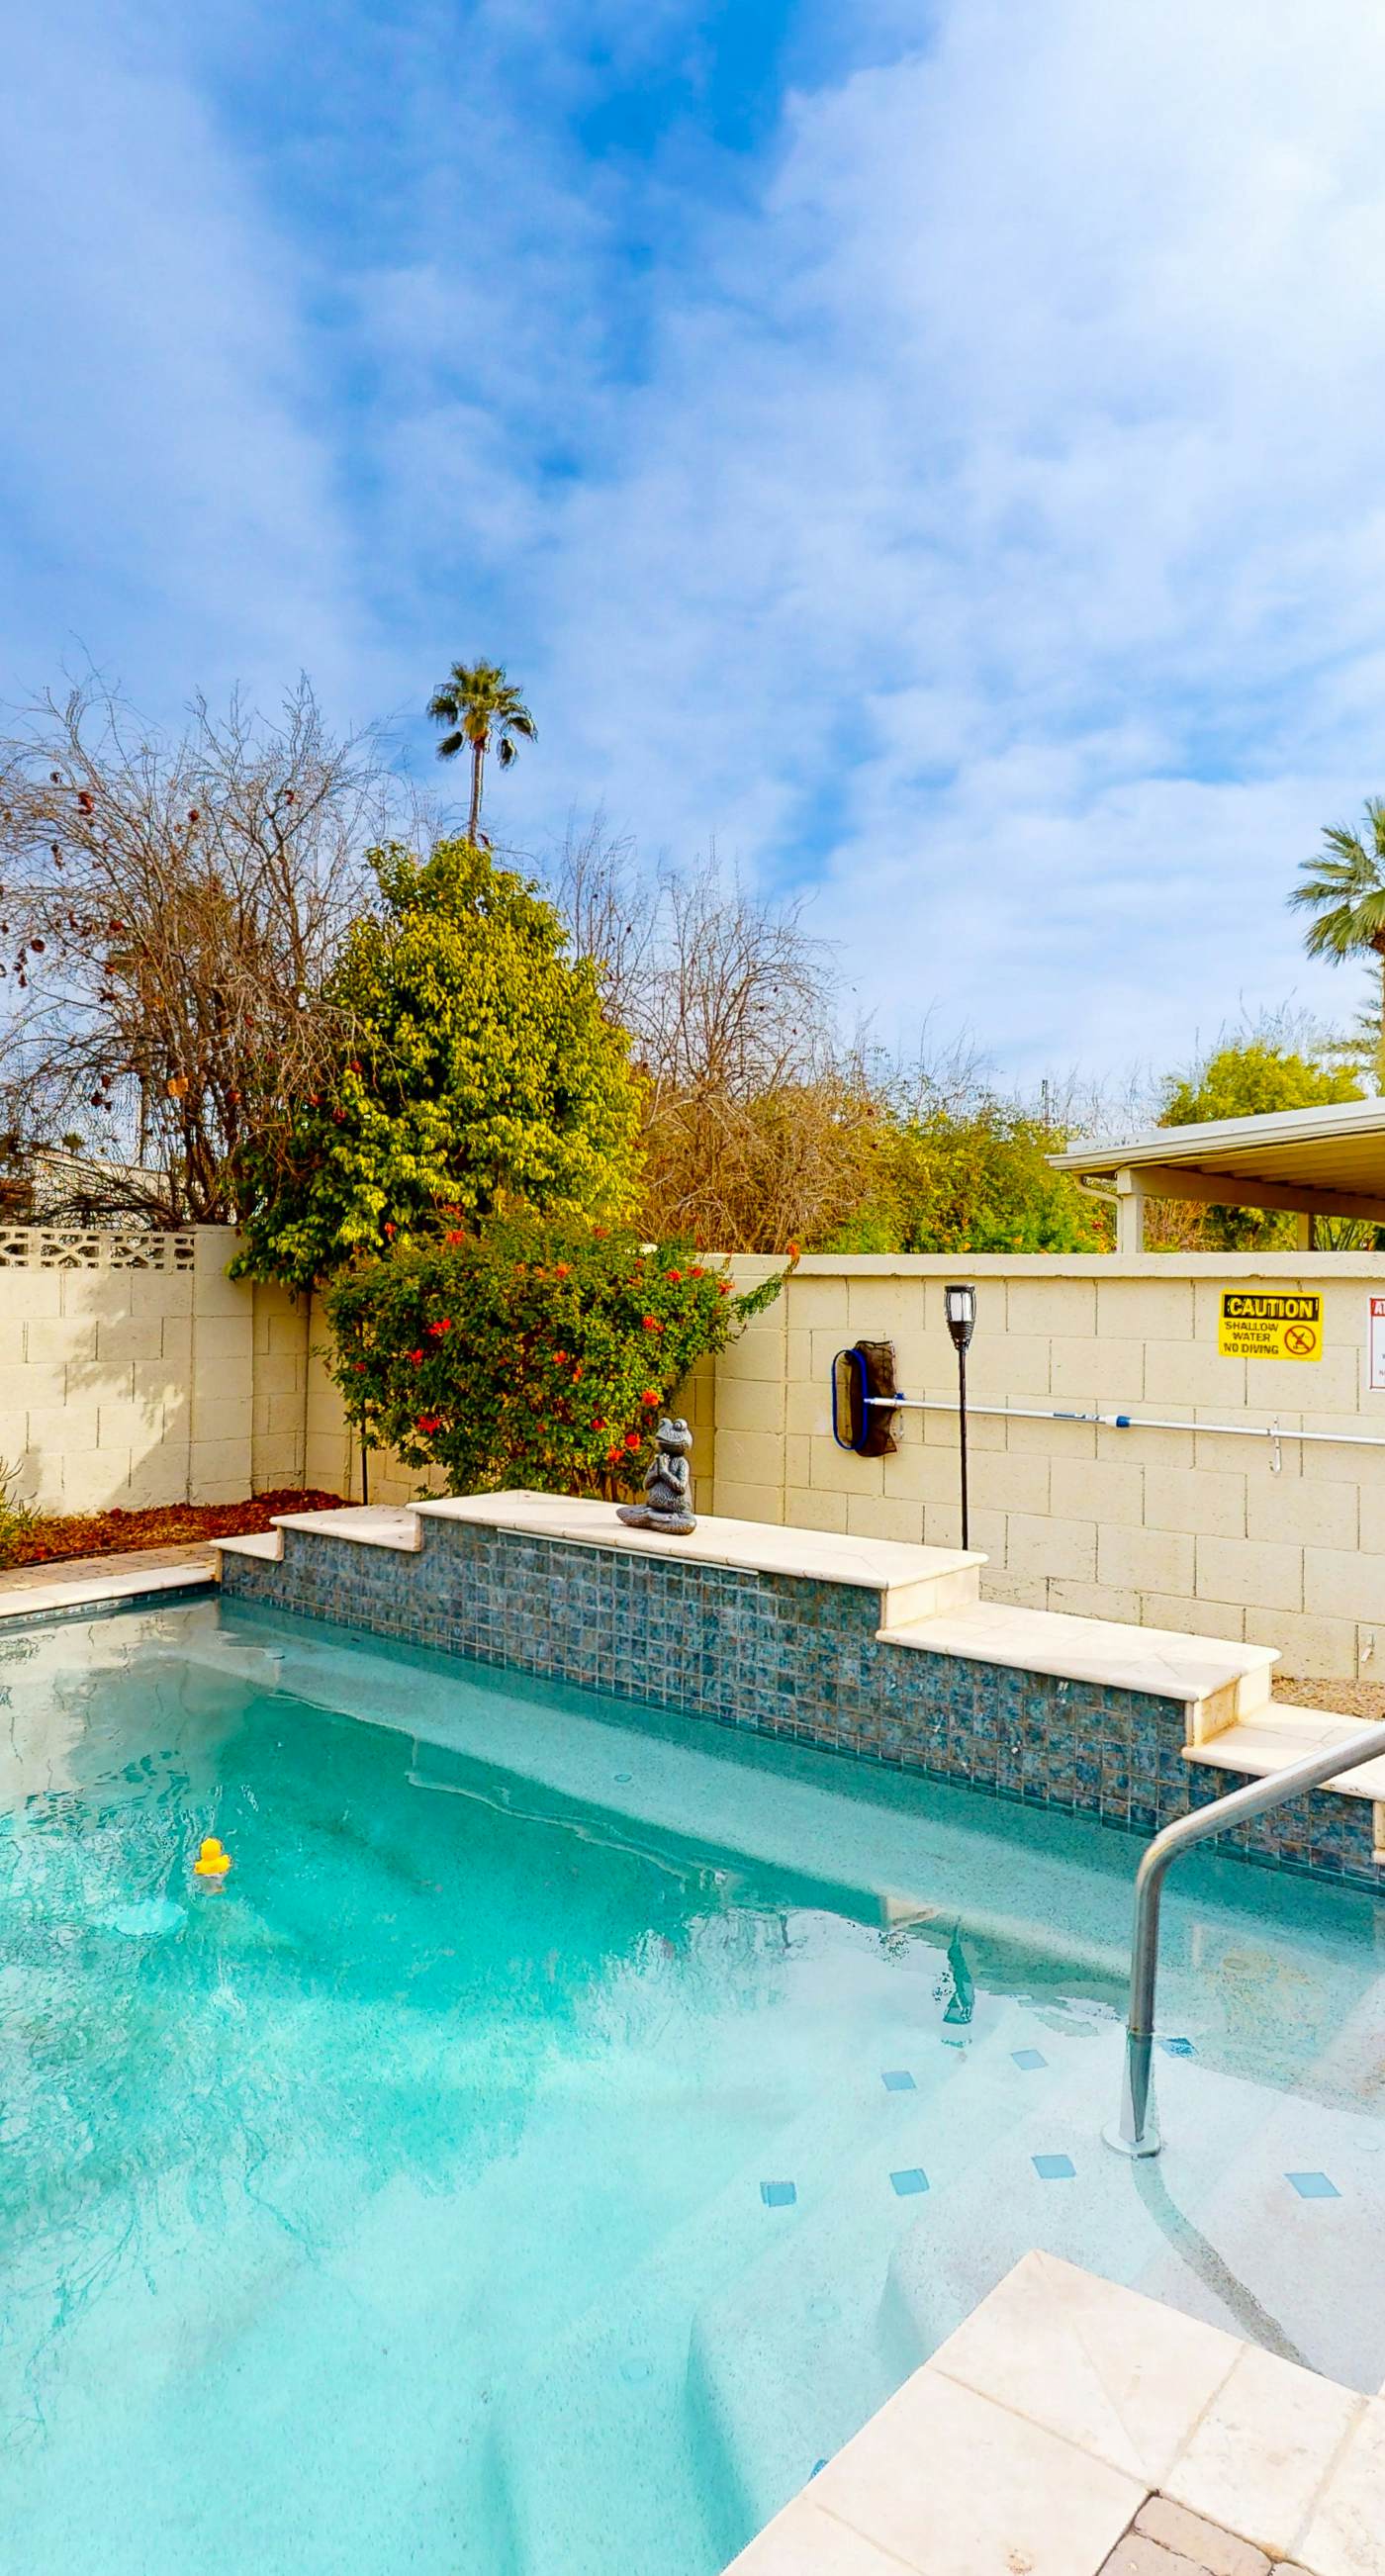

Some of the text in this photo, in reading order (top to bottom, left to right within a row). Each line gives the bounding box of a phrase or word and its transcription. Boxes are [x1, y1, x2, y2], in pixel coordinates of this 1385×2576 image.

[1229, 1298, 1313, 1318] CAUTION
[1225, 1321, 1278, 1332] SHALLOW
[1233, 1333, 1270, 1341] WATER
[1224, 1343, 1279, 1354] NO DIVING
